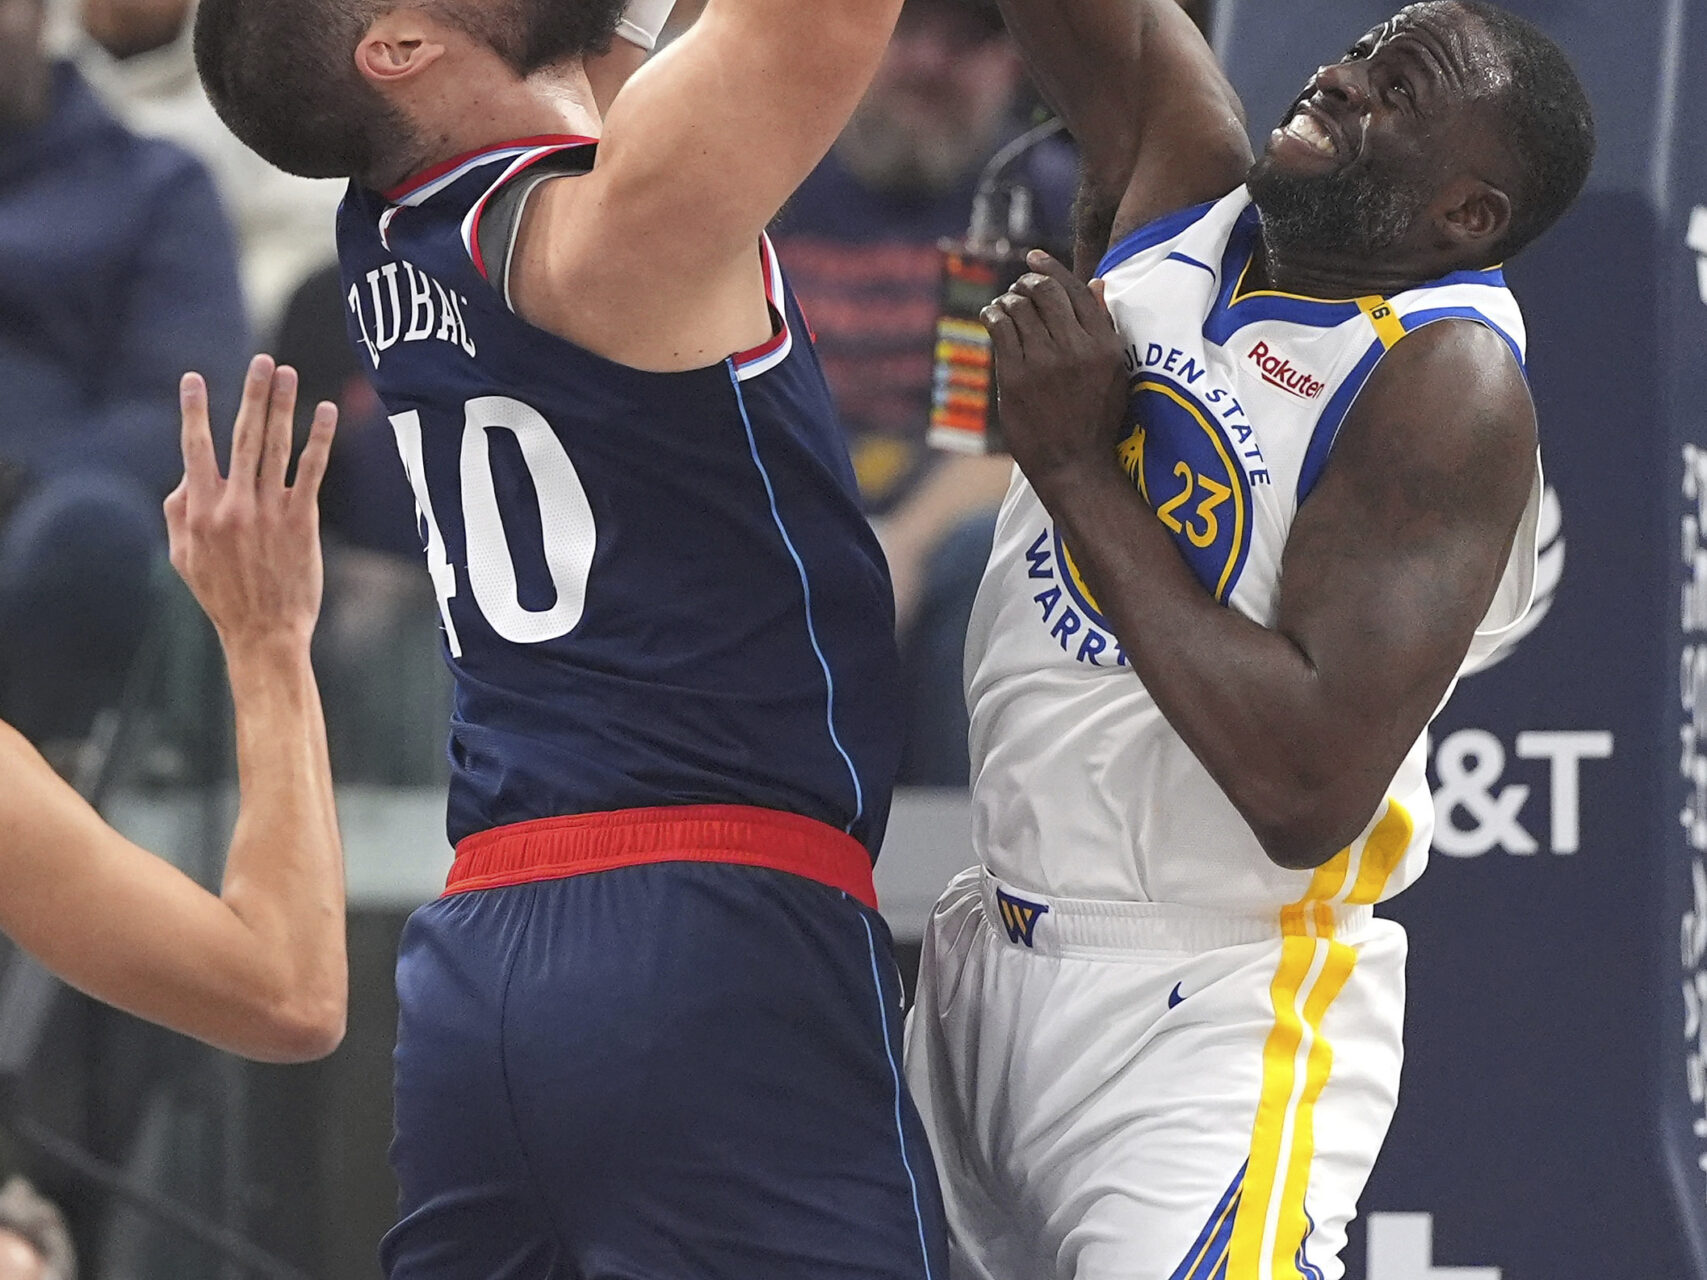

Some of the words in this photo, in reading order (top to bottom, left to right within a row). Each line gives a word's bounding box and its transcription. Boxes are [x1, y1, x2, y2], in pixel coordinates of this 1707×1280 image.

[1247, 341, 1325, 399] Rakuten
[1205, 388, 1271, 486] STATE
[1156, 460, 1232, 548] 23
[1431, 728, 1614, 858] &T
